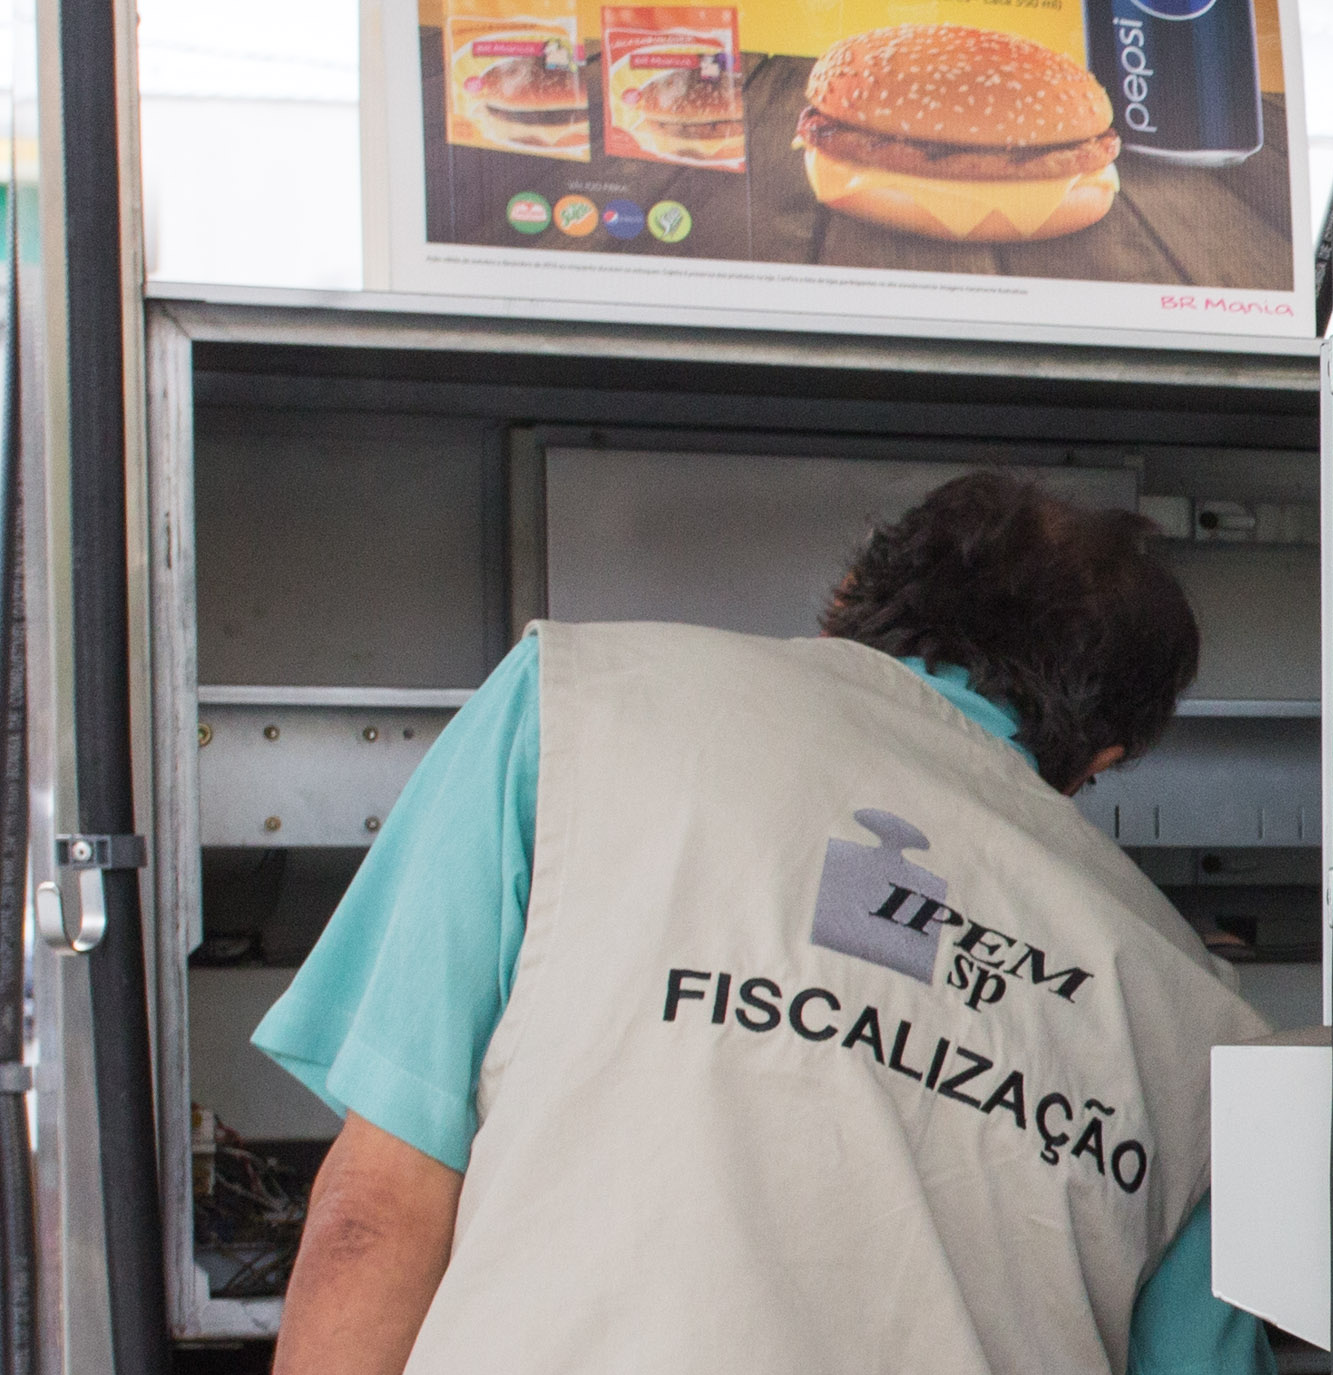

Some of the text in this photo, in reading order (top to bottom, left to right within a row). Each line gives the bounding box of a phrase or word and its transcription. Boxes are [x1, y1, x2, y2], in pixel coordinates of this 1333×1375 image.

[1112, 16, 1158, 134] pepsi
[1160, 295, 1295, 318] BR Mania
[869, 882, 1095, 1004] IPEM
[946, 953, 1008, 1013] sp
[662, 968, 1148, 1194] FISCALIZAÇÃO
